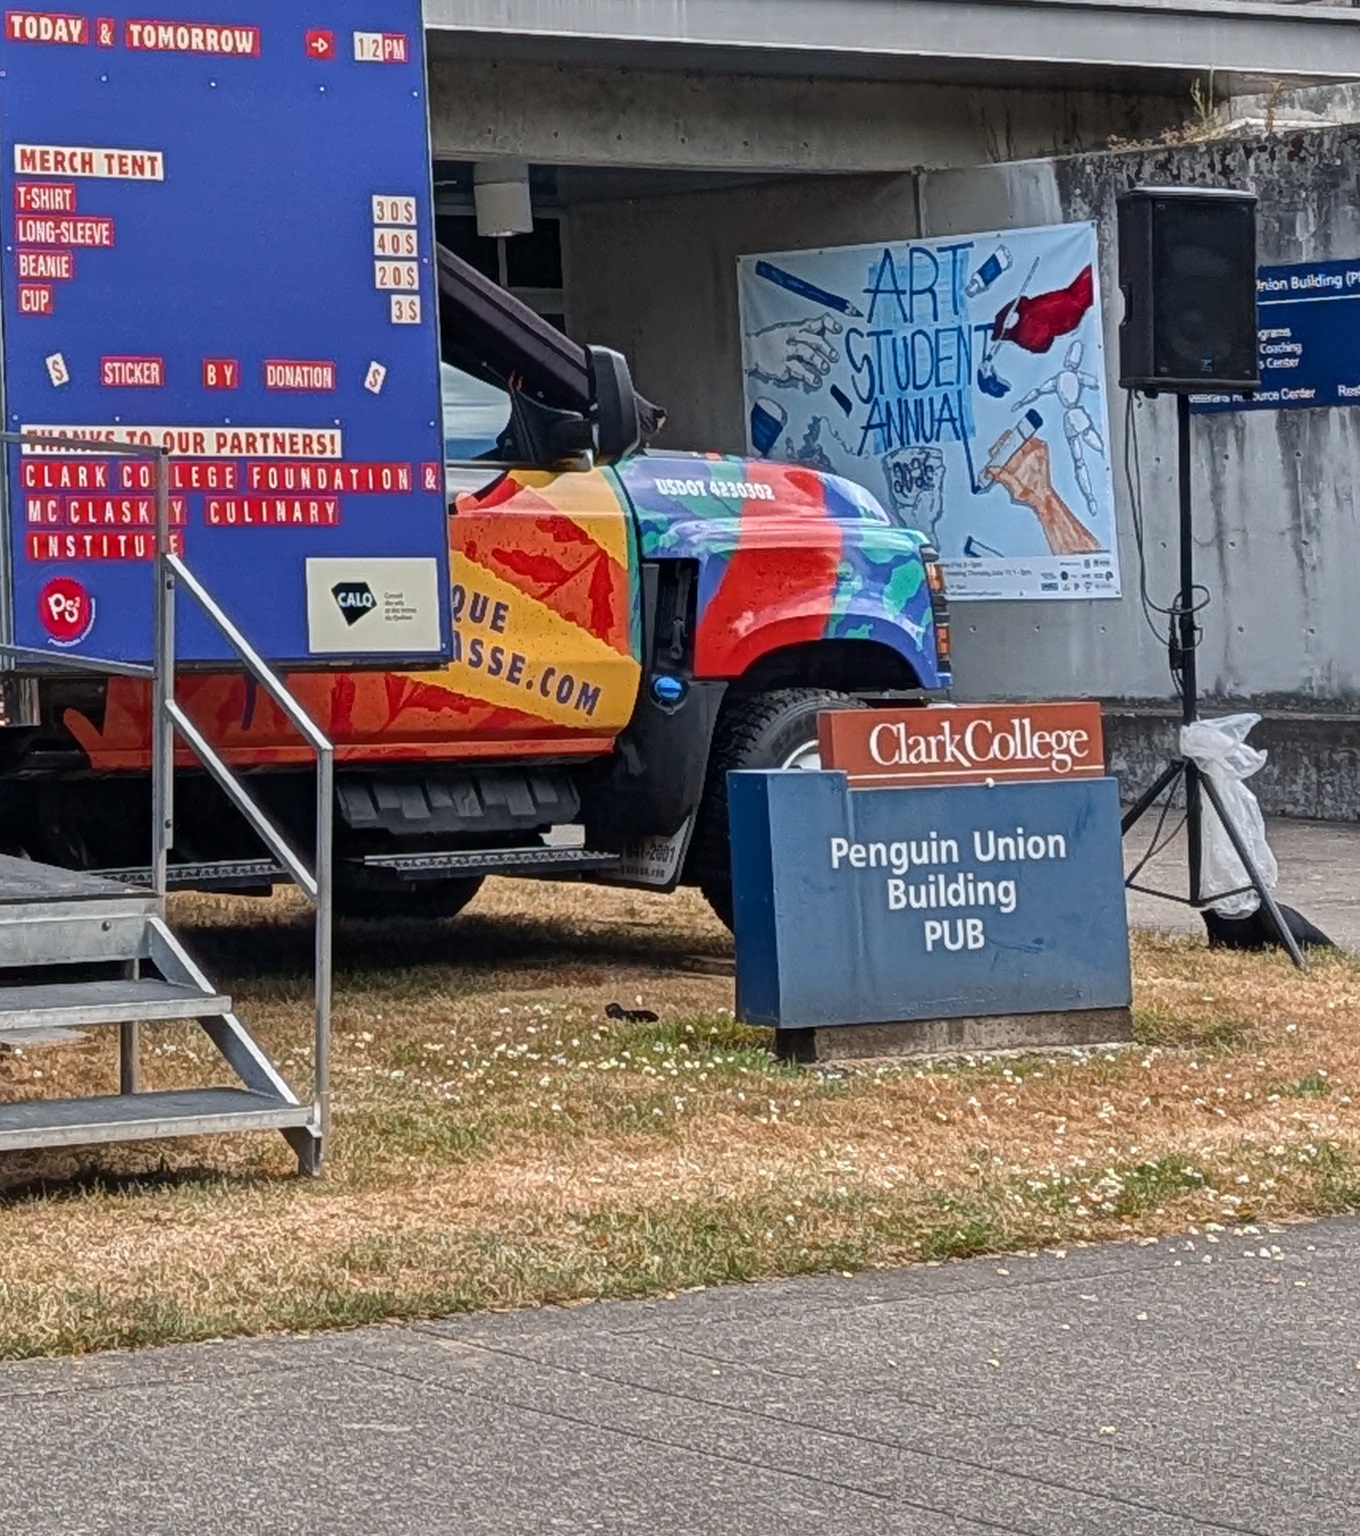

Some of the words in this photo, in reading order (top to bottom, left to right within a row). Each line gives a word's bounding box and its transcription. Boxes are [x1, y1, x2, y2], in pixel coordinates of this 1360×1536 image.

[11, 15, 83, 43] TODAY
[99, 22, 114, 46] &
[129, 23, 255, 55] TOMORROW
[19, 148, 95, 174] MERCH
[104, 153, 159, 177] TENT
[17, 186, 73, 211] T-SHIRT
[376, 200, 414, 223] 30$
[17, 219, 111, 246] LONG-SLEEVE
[377, 233, 415, 255] 40$
[18, 253, 71, 278] BEANIE
[378, 265, 416, 288] 20$
[863, 242, 975, 324] ART
[1291, 273, 1343, 289] Building
[20, 288, 51, 313] CUP
[393, 299, 418, 322] 3$
[844, 322, 996, 406] STUDENT
[1259, 341, 1303, 356] Coaching
[103, 362, 161, 386] STICKER
[206, 364, 234, 386] BY
[266, 364, 334, 389] DONATION
[1281, 387, 1316, 401] Center
[162, 430, 206, 455] OUR
[215, 431, 336, 456] PARTNERS!
[857, 387, 981, 495] ANNUAL
[25, 465, 108, 489] CLARK
[122, 465, 235, 490] COLEGE
[252, 466, 410, 490] FOUNDATION
[424, 468, 438, 491] &
[654, 478, 708, 497] USDOT
[69, 500, 184, 524] CLASKY
[209, 500, 336, 525] CULINARY
[32, 533, 180, 559] INSTITUE
[337, 592, 374, 608] CALQ
[868, 720, 972, 768] Clark
[964, 717, 1090, 773] College
[829, 830, 960, 875] Penguin
[972, 826, 1067, 863] Union
[886, 873, 1018, 914] Building
[923, 917, 985, 953] PUB
